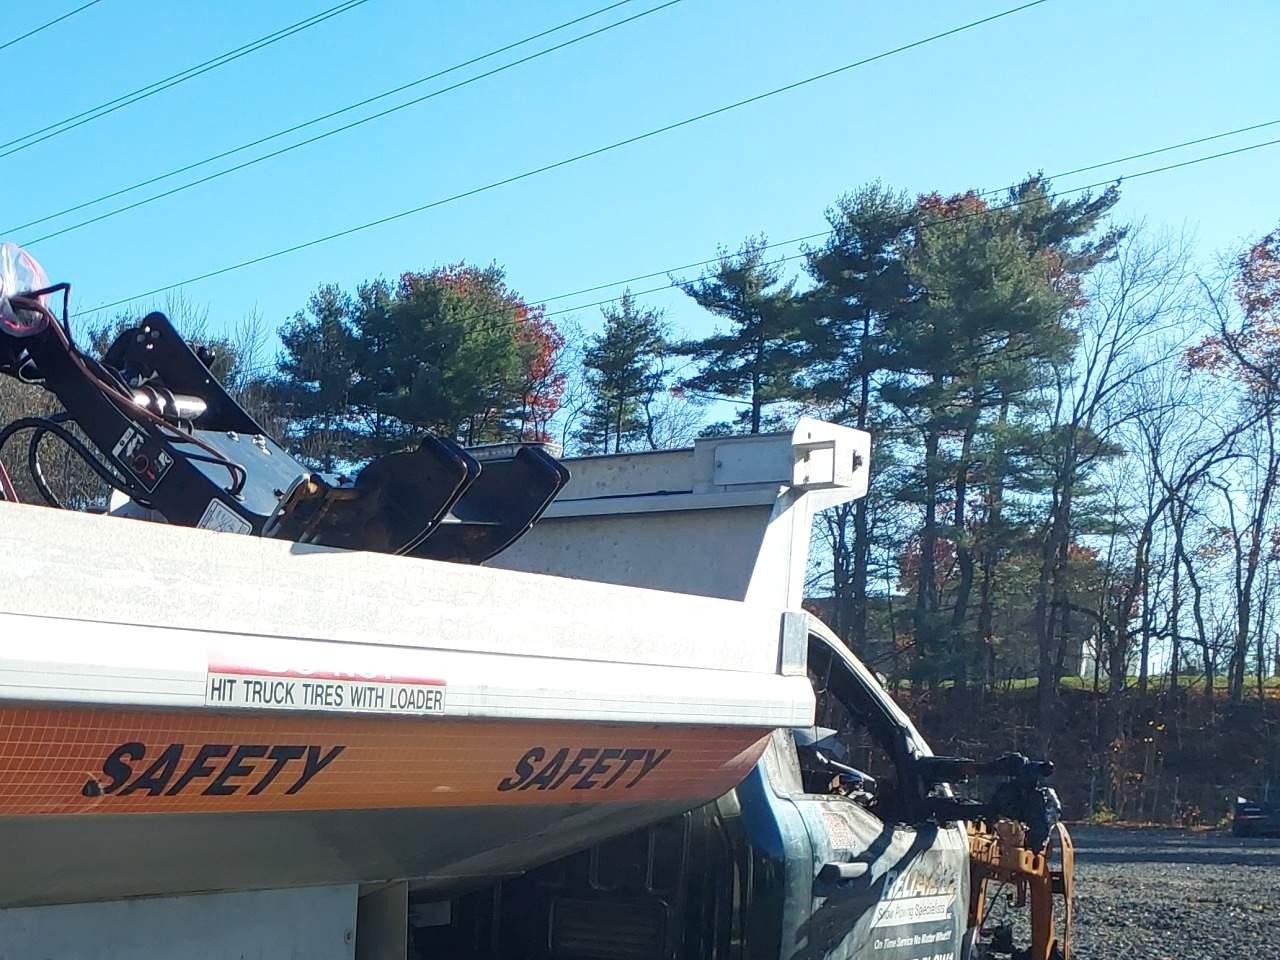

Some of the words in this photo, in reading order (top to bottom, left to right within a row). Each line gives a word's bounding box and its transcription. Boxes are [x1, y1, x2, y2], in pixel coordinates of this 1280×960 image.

[211, 678, 237, 702] HIT
[243, 680, 295, 704] TRUCK
[302, 683, 344, 707] TIRES
[350, 686, 384, 708] WITH
[390, 688, 443, 711] LOADER
[82, 742, 347, 797] SAFETY
[496, 746, 672, 792] SAFETY
